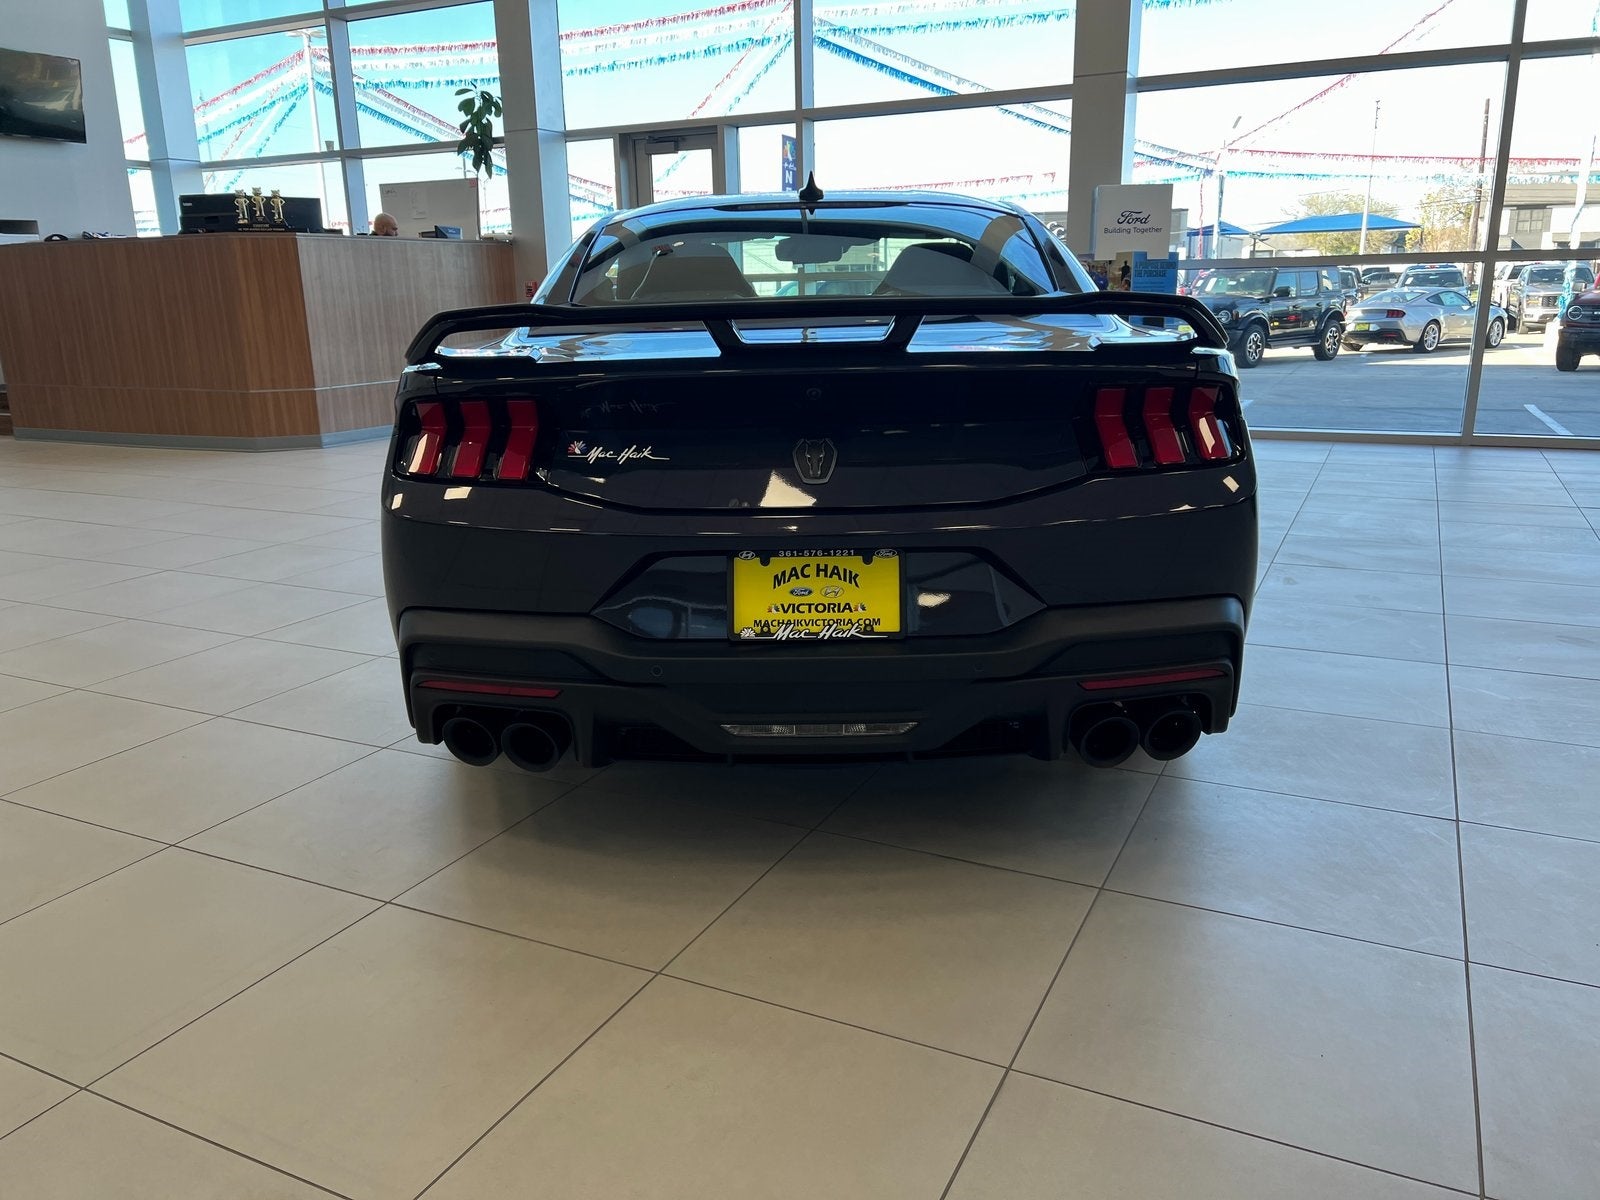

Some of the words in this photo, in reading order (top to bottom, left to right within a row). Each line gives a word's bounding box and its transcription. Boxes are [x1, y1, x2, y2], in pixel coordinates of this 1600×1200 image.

[1117, 210, 1151, 225] Ford
[1104, 227, 1131, 235] Building
[1133, 226, 1162, 234] Together
[587, 446, 617, 464] Mac
[617, 445, 657, 465] Haik
[778, 549, 854, 557] 361-576-1221
[773, 563, 811, 590] MAC
[816, 563, 860, 588] HAIK
[791, 587, 811, 596] Ford
[780, 602, 854, 614] VICTORIA
[753, 618, 881, 628] MACHAIKVICTORIACOM
[774, 622, 817, 641] Mac
[818, 622, 869, 640] Haik
